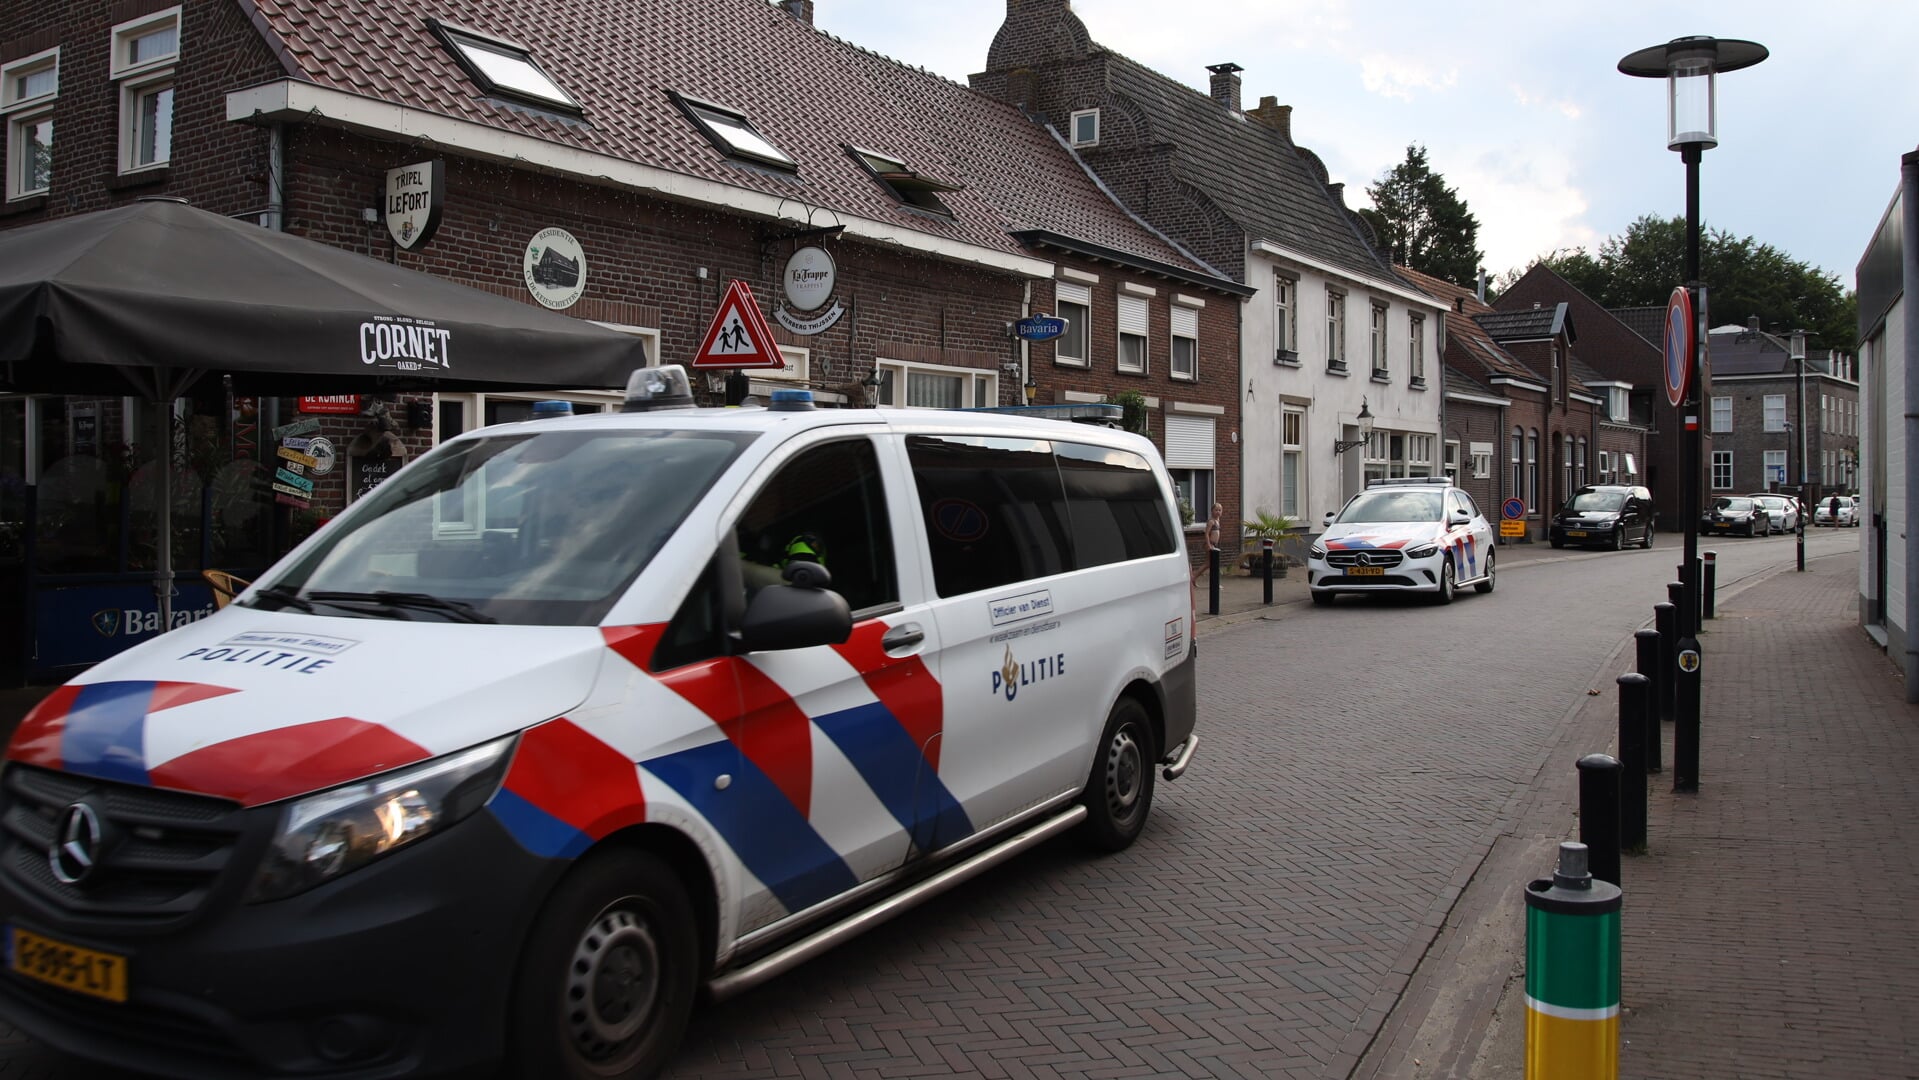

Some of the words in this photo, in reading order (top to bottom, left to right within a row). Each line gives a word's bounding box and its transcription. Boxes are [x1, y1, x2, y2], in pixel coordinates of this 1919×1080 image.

[396, 171, 423, 190] TRIPEL
[538, 229, 575, 246] RESIDENTIE
[791, 269, 801, 284] La
[800, 268, 829, 282] Trappe
[781, 315, 807, 330] HERBERG
[808, 311, 836, 330] THIJSSEN
[1020, 323, 1058, 335] Bavaria
[359, 322, 450, 369] CORNET
[397, 361, 417, 371] OAKED
[993, 604, 1017, 618] Officier
[1018, 602, 1030, 612] van
[1030, 597, 1050, 610] Dienst
[124, 603, 213, 635] Baari
[177, 648, 336, 674] POLITIE
[992, 653, 1064, 701] POLITIE
